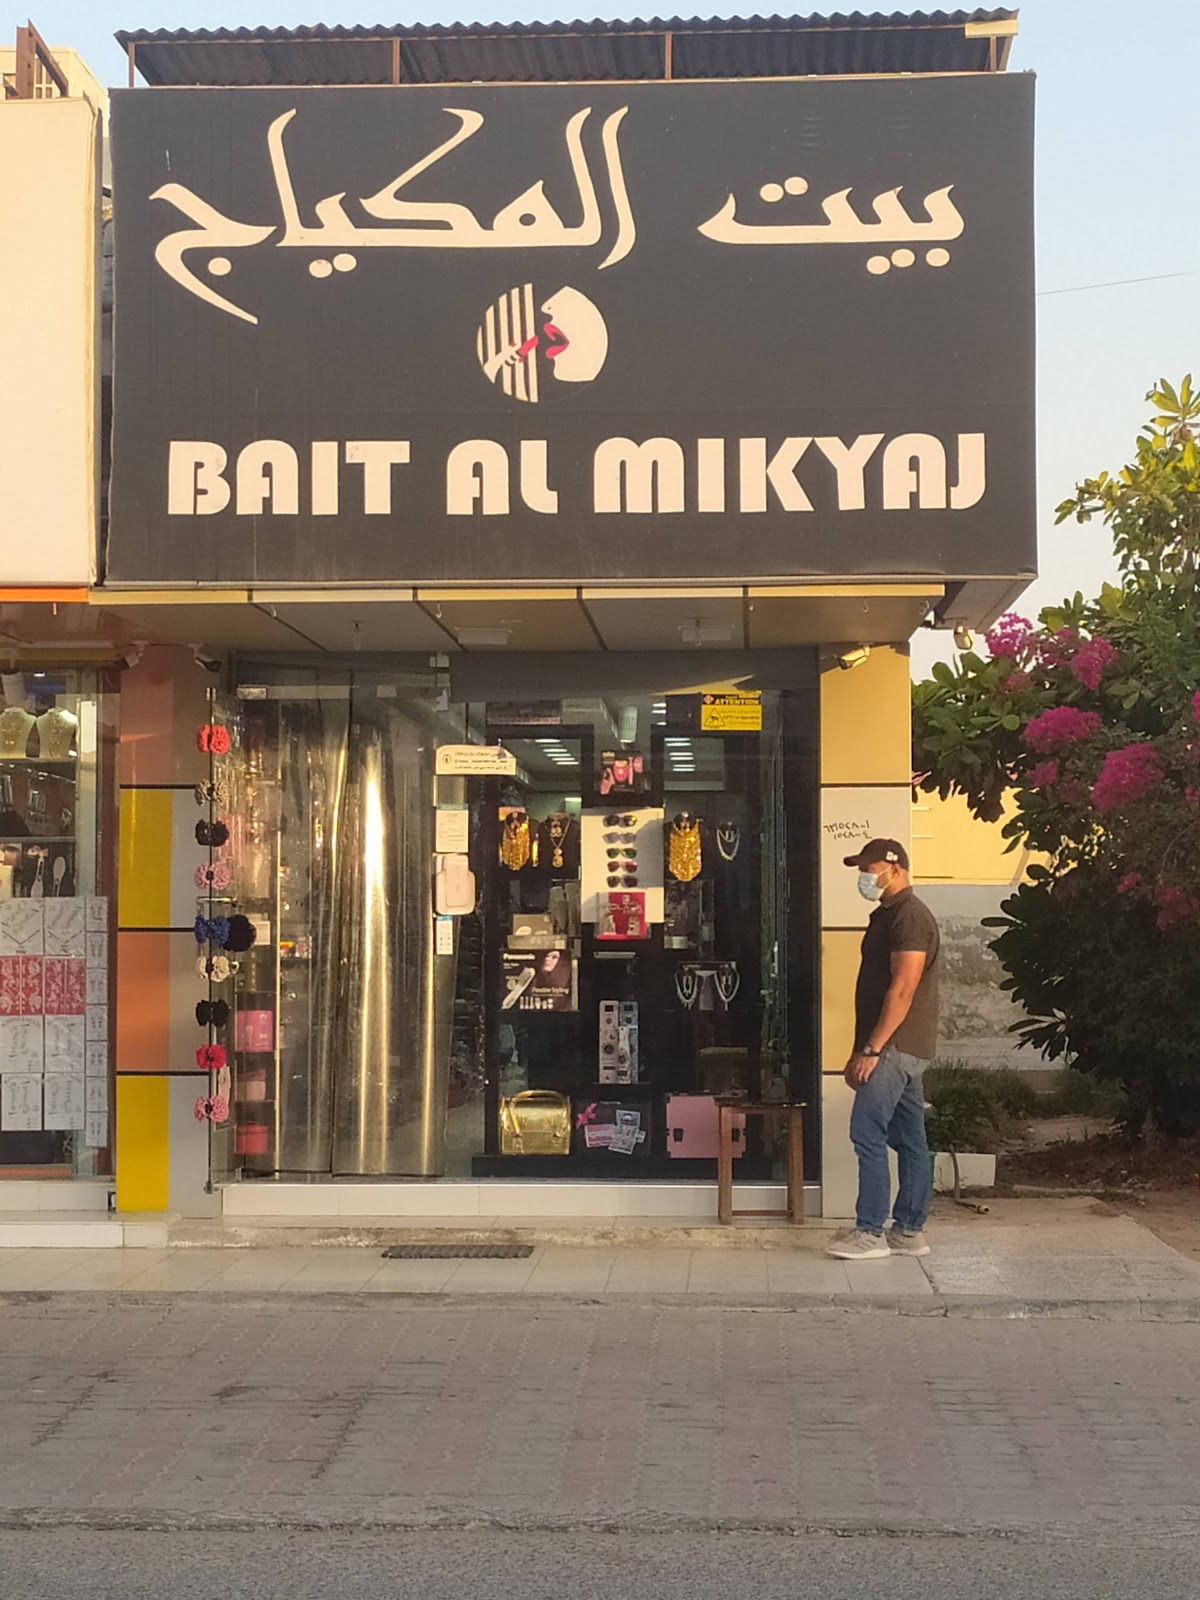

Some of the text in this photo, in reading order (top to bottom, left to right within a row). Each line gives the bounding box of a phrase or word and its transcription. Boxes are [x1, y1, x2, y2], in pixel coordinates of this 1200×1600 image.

[149, 106, 965, 325] بيت المكياج
[168, 433, 985, 515] BAIT AL MIKYAJ
